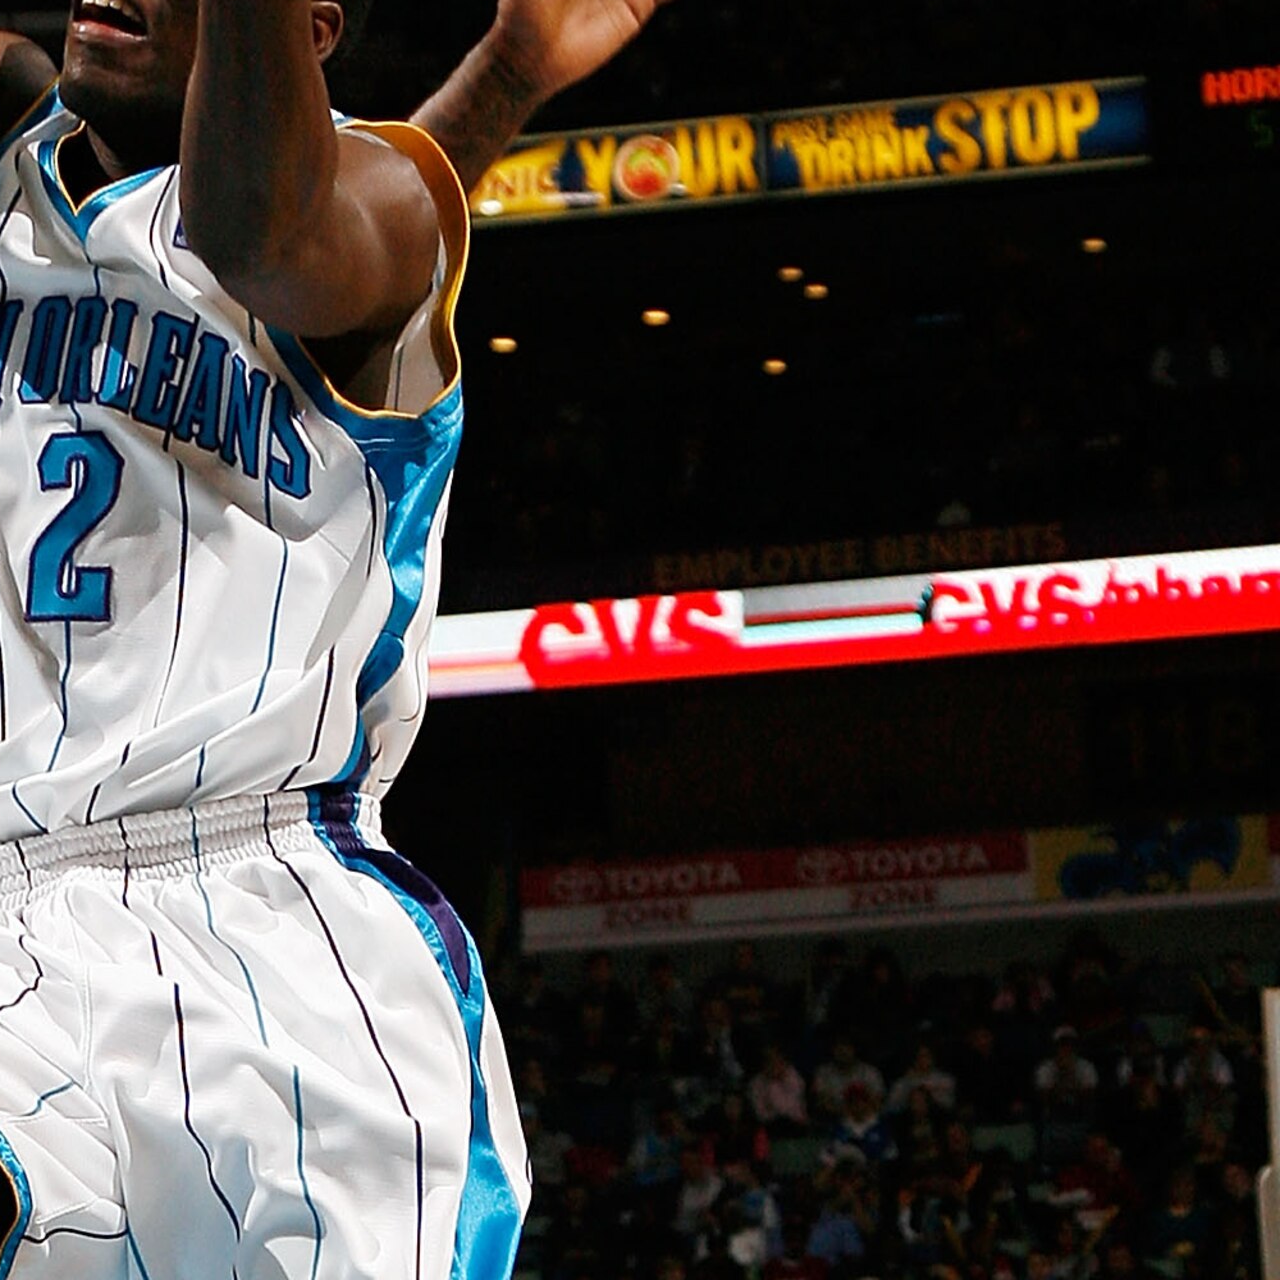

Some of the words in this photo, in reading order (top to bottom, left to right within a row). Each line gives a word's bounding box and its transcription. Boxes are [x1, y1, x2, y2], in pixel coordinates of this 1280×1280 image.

[793, 125, 934, 194] DRINK
[934, 81, 1101, 175] STOP
[17, 295, 312, 500] ORLEANS
[24, 428, 125, 622] 2
[605, 858, 743, 898] TOYOTA
[851, 840, 990, 879] TOYOTA
[601, 897, 692, 929] ZONE
[849, 881, 939, 910] ZONE
